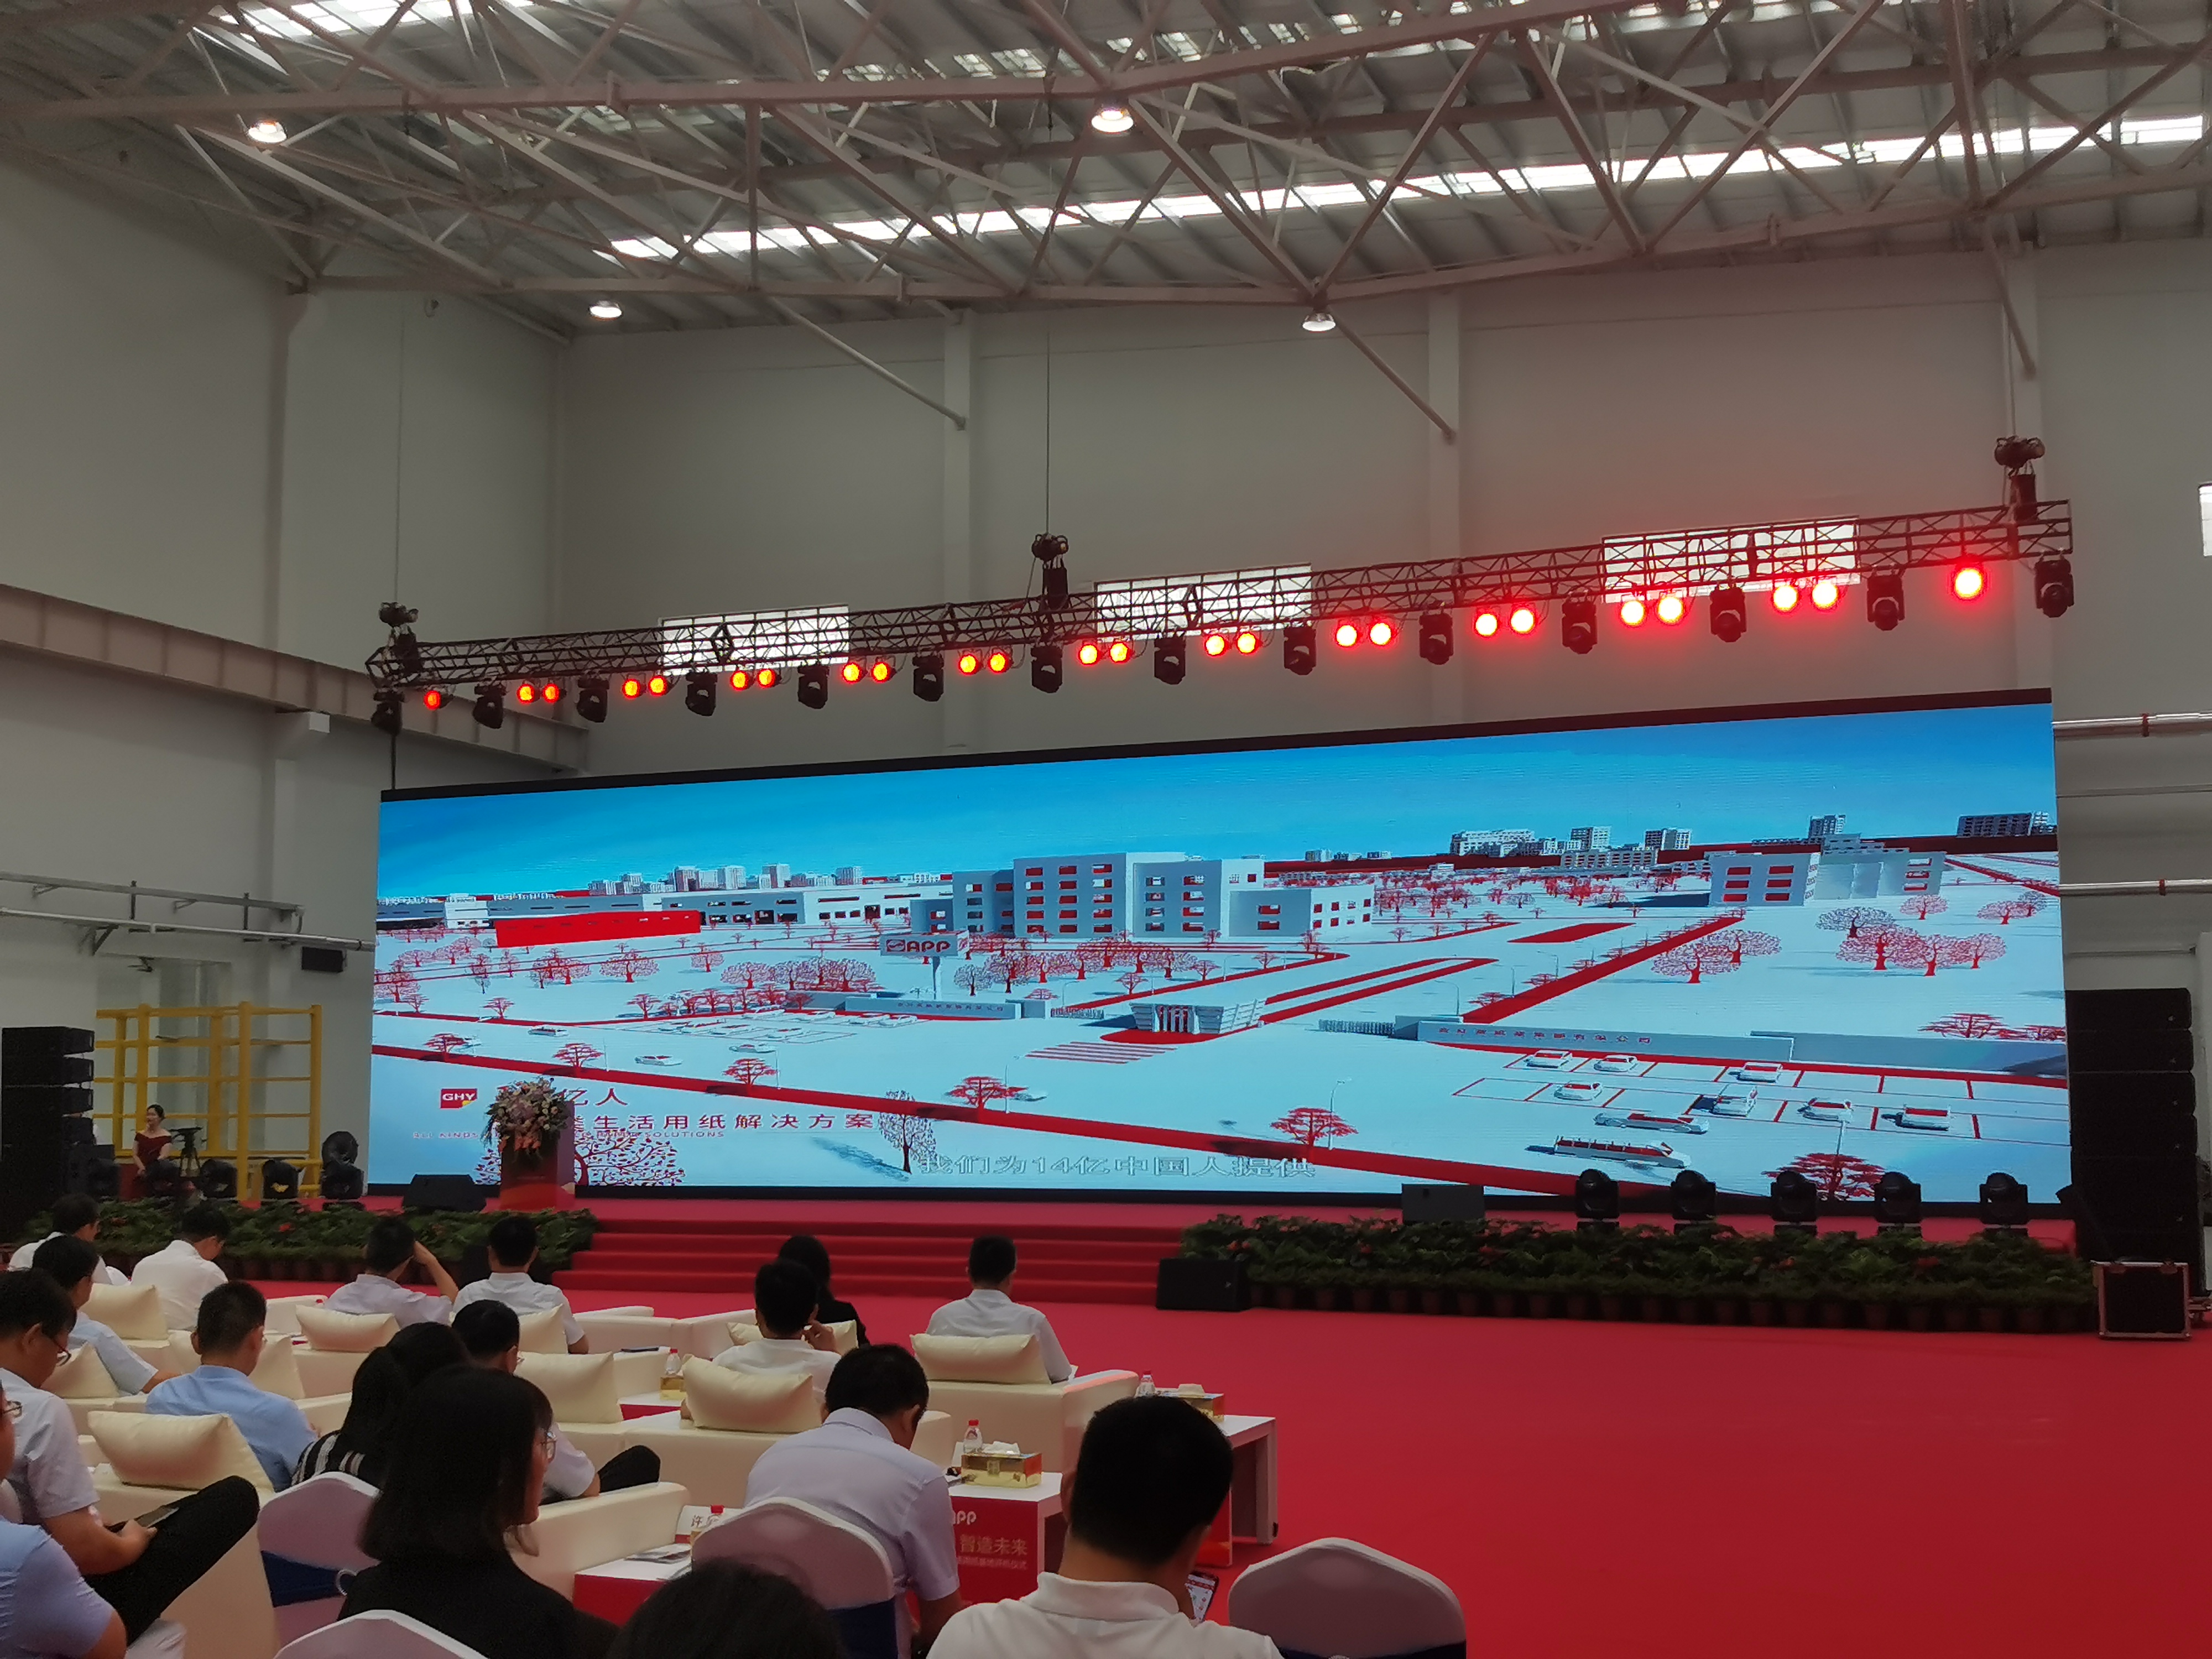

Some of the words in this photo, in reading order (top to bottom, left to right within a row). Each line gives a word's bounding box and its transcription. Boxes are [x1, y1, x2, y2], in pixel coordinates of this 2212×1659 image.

[906, 940, 951, 952] APP
[917, 1155, 1316, 1177] 我们为14亿中国人提供
